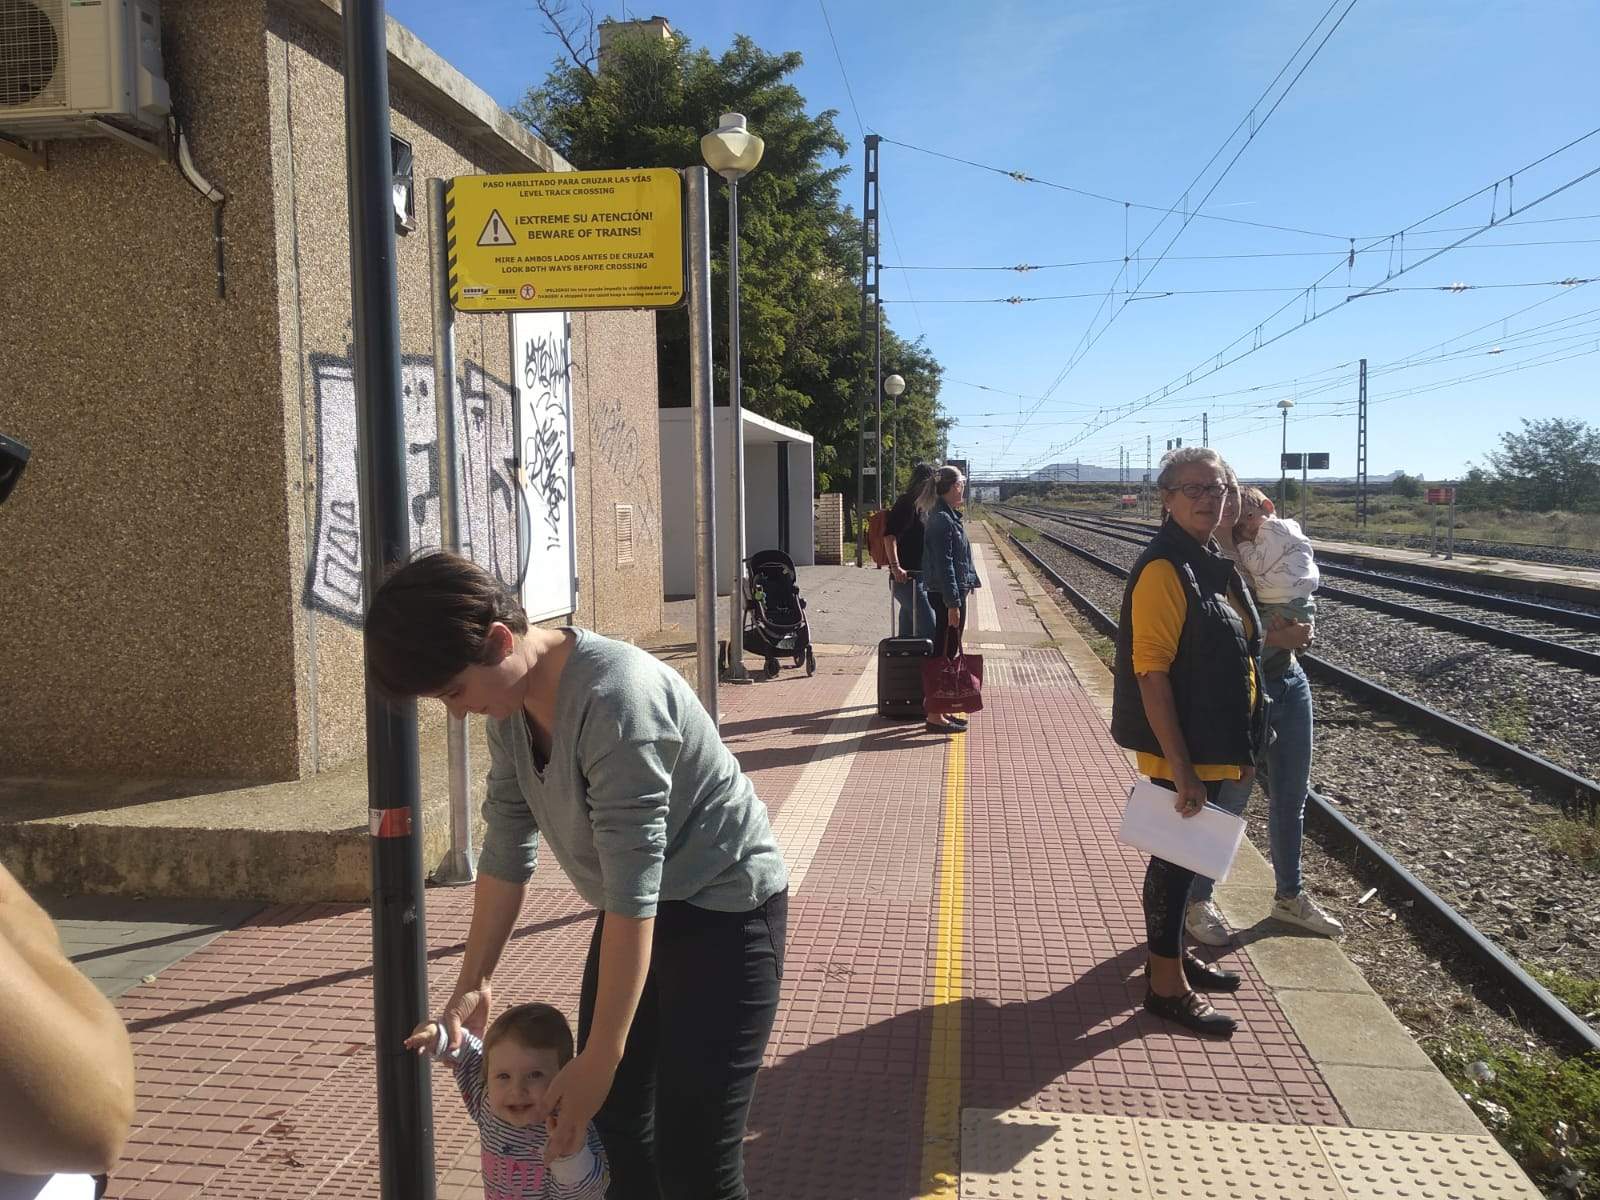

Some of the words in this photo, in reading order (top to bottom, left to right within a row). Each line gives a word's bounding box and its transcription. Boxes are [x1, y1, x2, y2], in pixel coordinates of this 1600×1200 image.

[506, 179, 556, 188] HABILITADO
[558, 178, 580, 186] PARA
[581, 176, 614, 185] CRUZAR
[615, 176, 631, 184] LAS
[519, 190, 544, 198] LEVEL
[573, 187, 615, 195] CROSSING
[515, 214, 570, 225] ¡EXTREME
[573, 213, 588, 223] SU
[591, 209, 653, 223] ATENCIÓN!
[528, 229, 574, 240] BEWARE
[577, 229, 593, 238] OF
[595, 227, 641, 237] TRAINS!
[623, 252, 655, 260] CRUZAR
[525, 265, 547, 273] BOTH
[548, 264, 571, 272] WAYS
[573, 263, 605, 271] BEFORE
[606, 262, 648, 270] CROSSING
